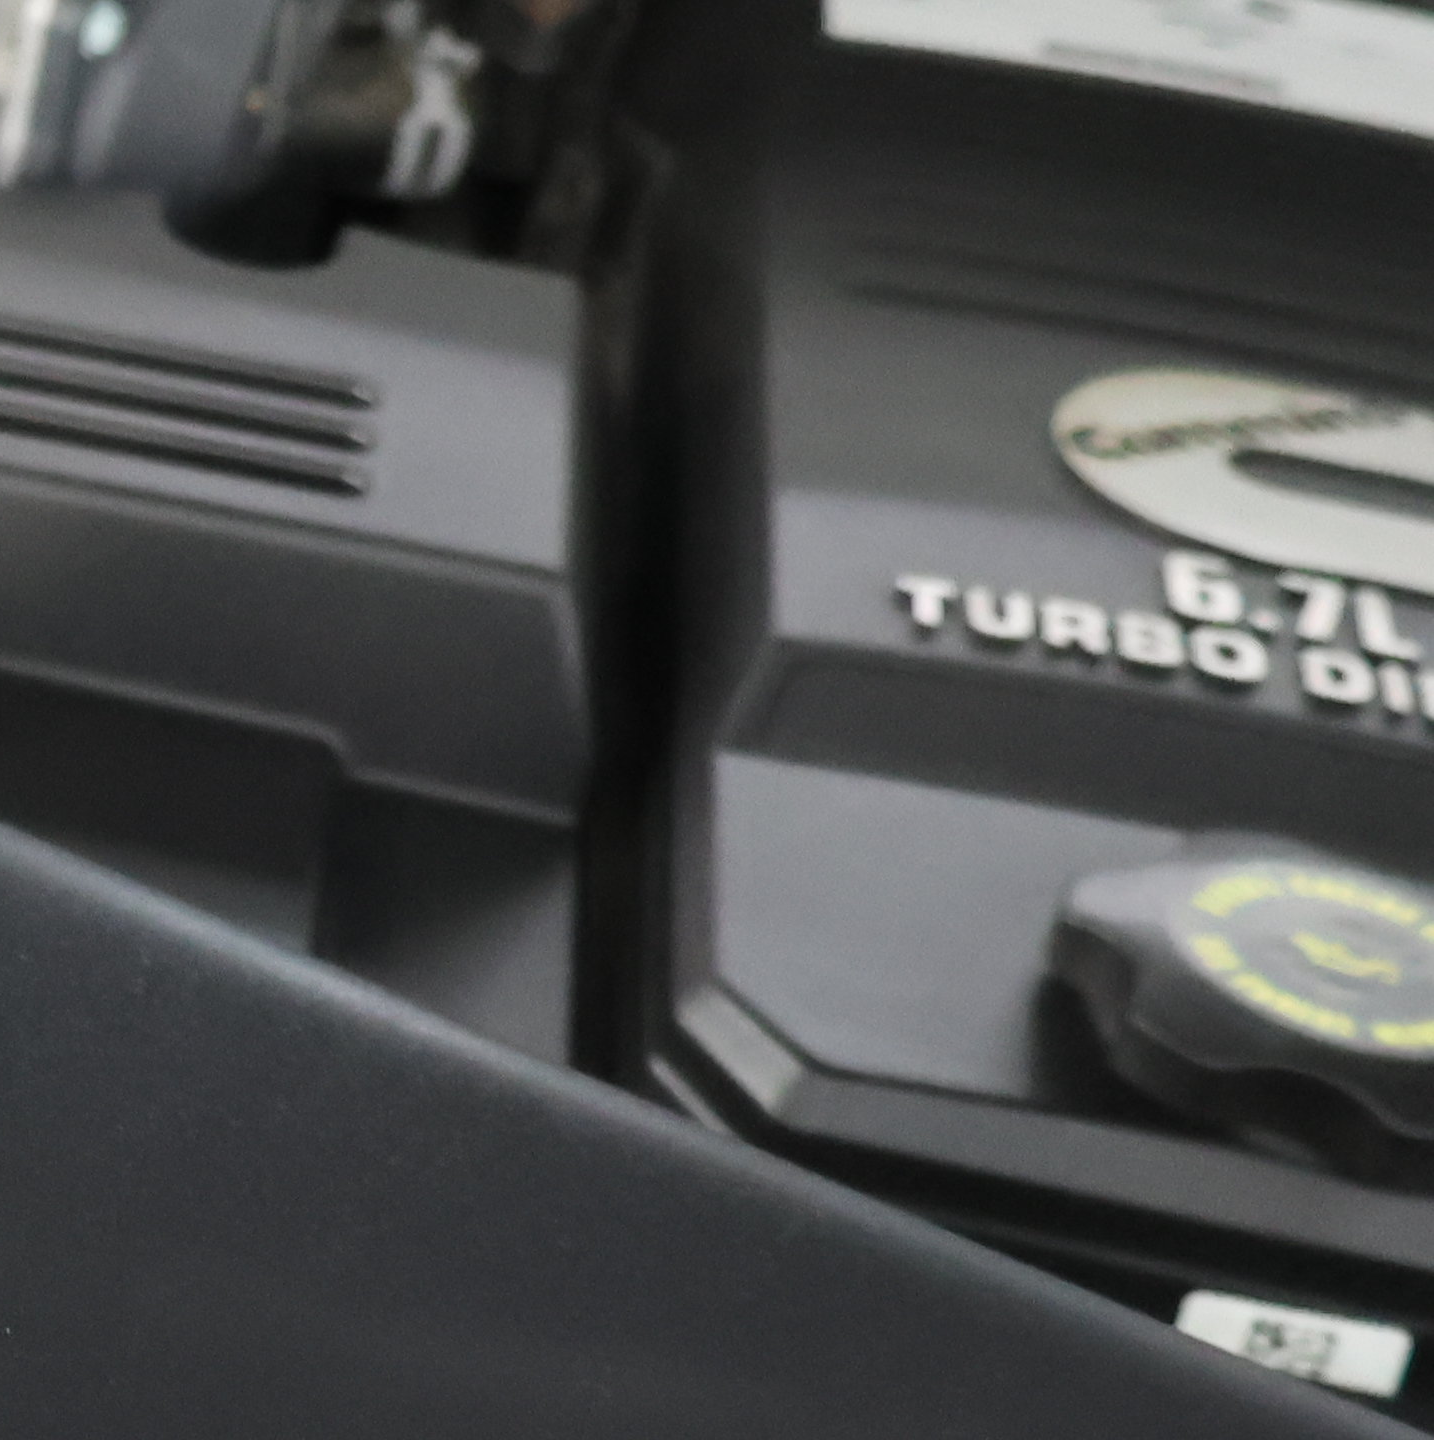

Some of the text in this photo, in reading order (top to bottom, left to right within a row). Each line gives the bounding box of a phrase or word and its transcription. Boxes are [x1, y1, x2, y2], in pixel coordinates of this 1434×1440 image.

[896, 574, 1434, 722] TURBO DI
[1161, 550, 1423, 659] 6.7L
